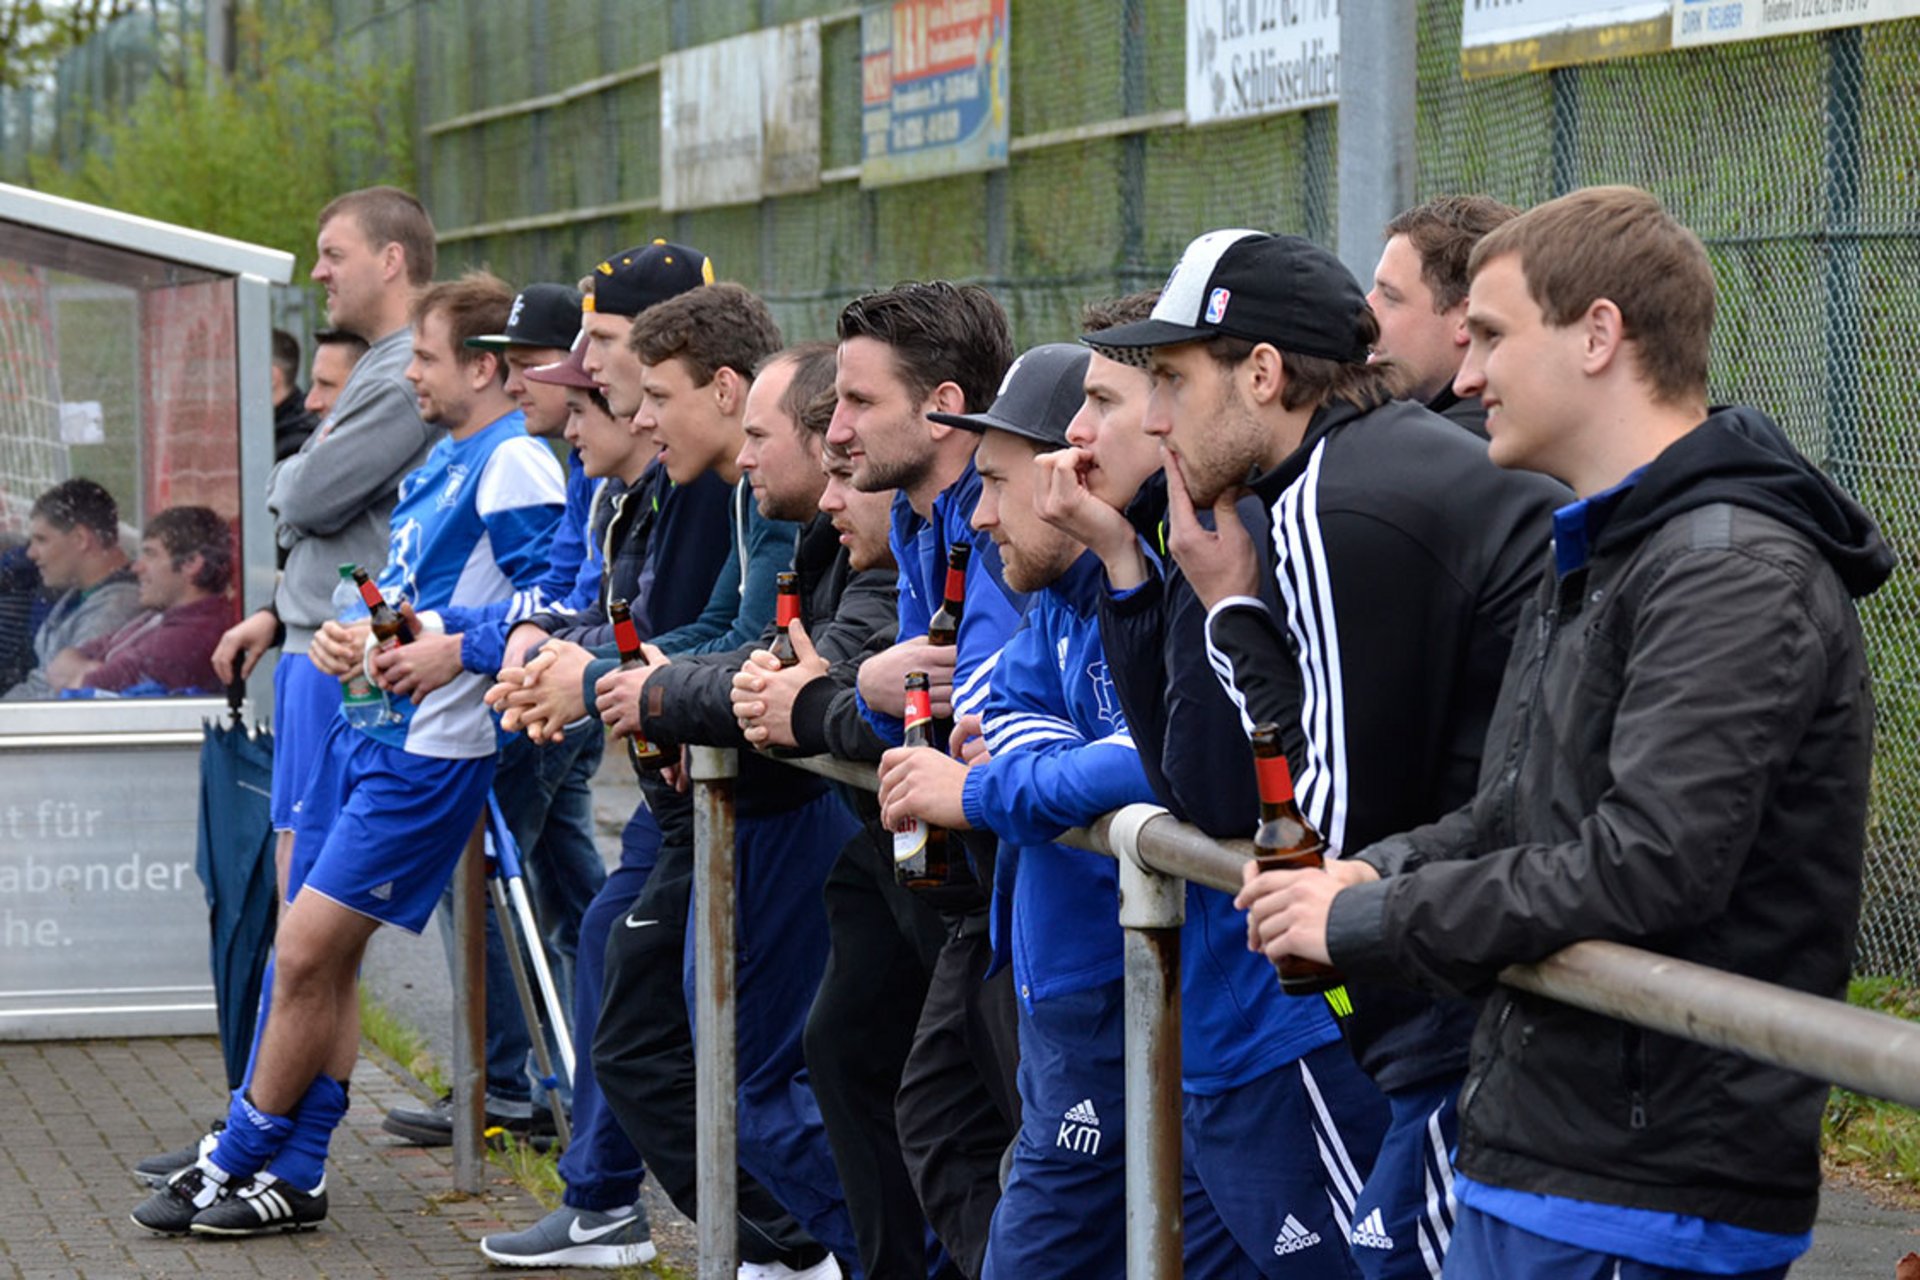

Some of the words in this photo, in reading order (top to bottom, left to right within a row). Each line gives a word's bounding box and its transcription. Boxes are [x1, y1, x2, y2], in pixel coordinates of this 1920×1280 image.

[1682, 10, 1702, 35] DIRK
[1708, 2, 1742, 30] REUBER
[37, 799, 103, 839] für
[0, 852, 190, 891] abender
[1064, 1111, 1100, 1126] adidas
[1056, 1121, 1102, 1156] KM
[1273, 1232, 1321, 1256] adidas
